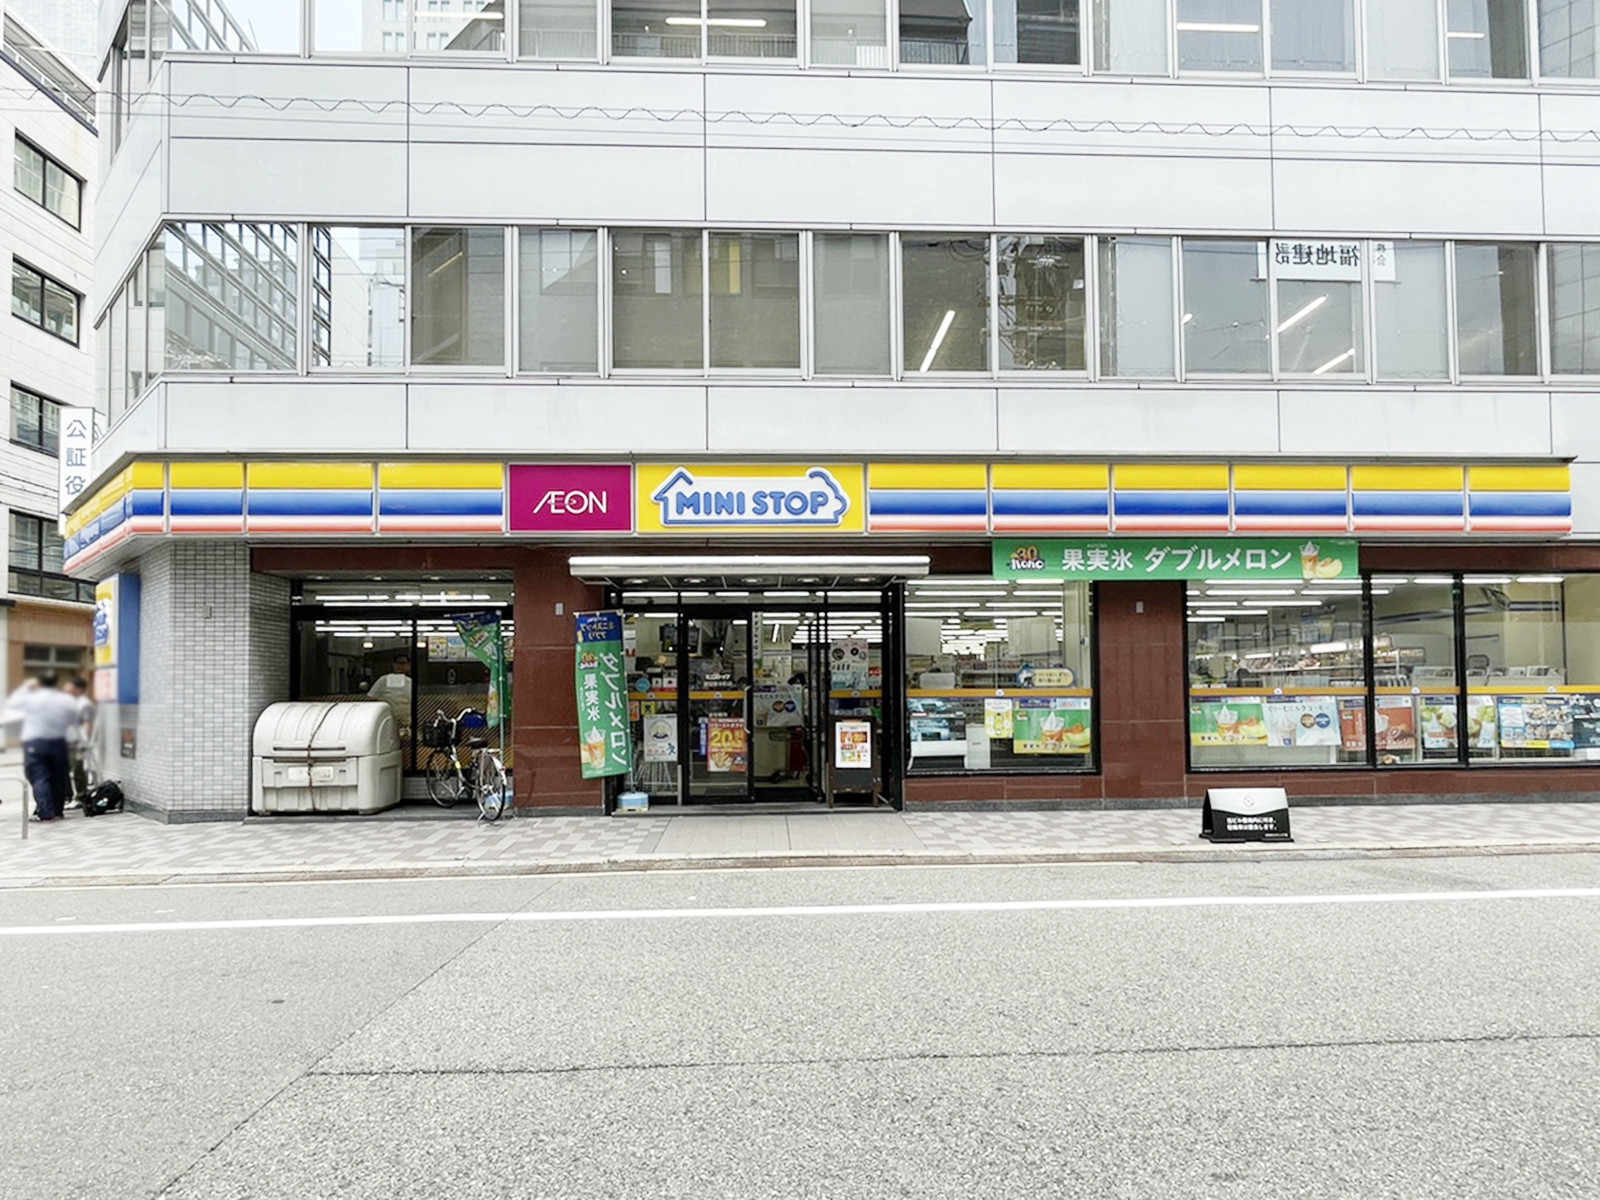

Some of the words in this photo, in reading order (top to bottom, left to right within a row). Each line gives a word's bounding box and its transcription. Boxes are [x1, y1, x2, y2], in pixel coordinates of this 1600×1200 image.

[65, 419, 86, 495] 公証役
[675, 491, 745, 515] MINI
[753, 490, 829, 515] STOP
[1062, 548, 1134, 571] 果実氷
[1144, 546, 1292, 572] ダブルメロン
